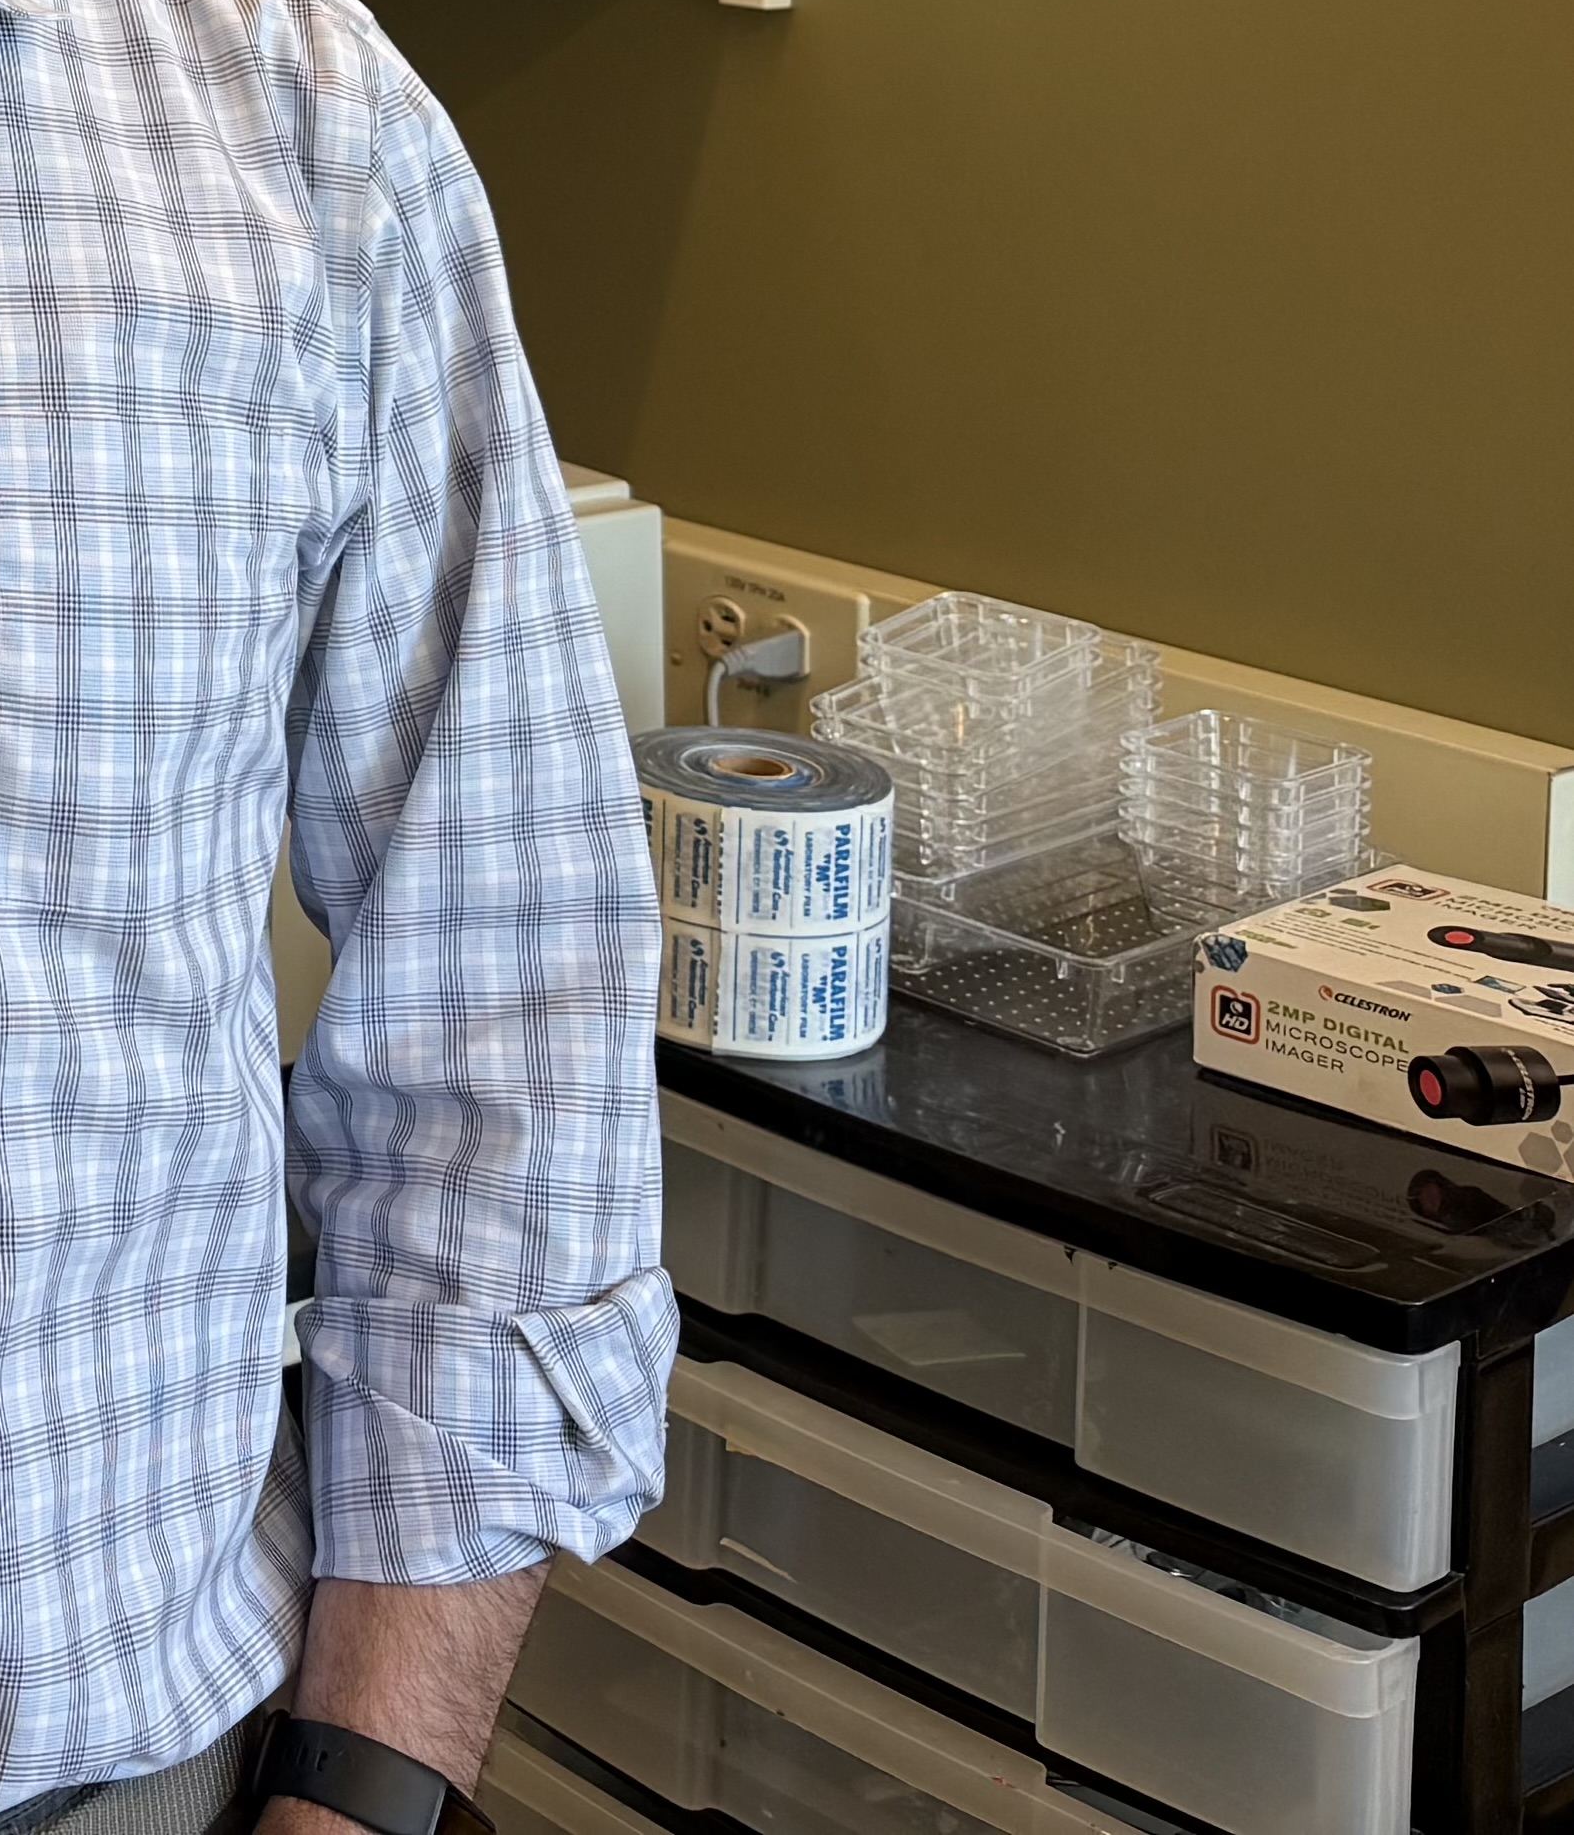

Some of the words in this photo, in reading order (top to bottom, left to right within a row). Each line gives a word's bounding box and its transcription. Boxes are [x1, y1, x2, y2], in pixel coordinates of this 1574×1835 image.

[832, 823, 852, 920] PARAFILM
[829, 945, 848, 1042] PARAFILM
[1334, 992, 1412, 1022] CELESTRON
[1221, 1012, 1250, 1031] HD
[1265, 1019, 1409, 1073] MICROSCOPE
[1267, 1000, 1316, 1025] 2MP
[1323, 1017, 1410, 1054] DIGITAL
[1265, 1038, 1345, 1074] IMAGER
